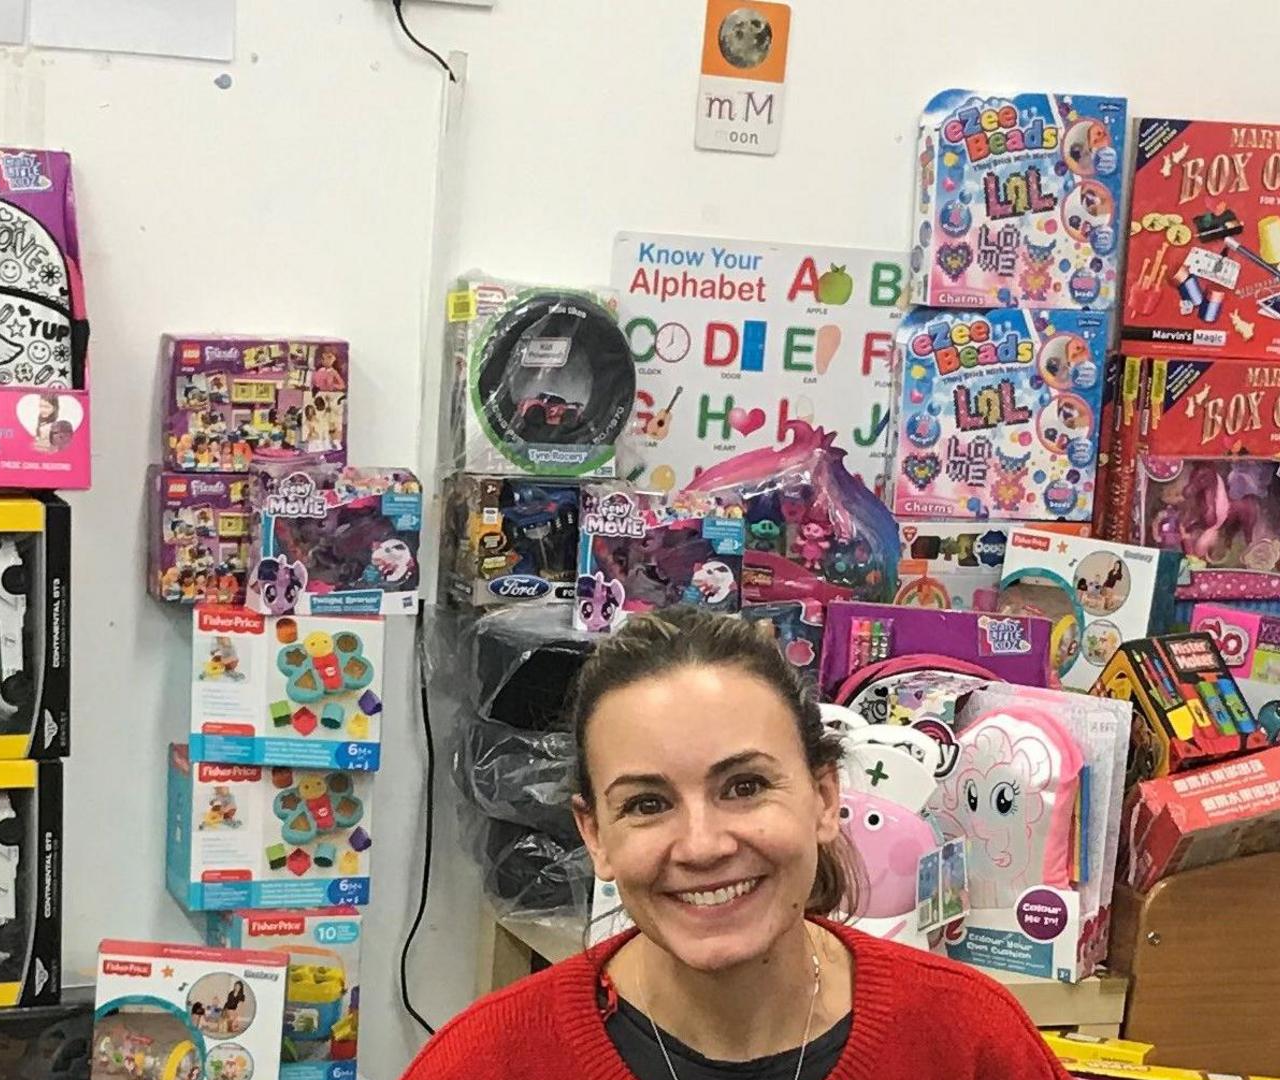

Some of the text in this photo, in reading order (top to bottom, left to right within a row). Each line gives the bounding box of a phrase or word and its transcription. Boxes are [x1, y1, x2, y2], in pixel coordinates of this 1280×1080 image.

[742, 91, 774, 125] M
[728, 131, 759, 145] oon
[966, 120, 1058, 162] Beads
[1179, 153, 1253, 204] BOX
[639, 243, 764, 271] Know Your
[629, 268, 767, 303] Alphabet
[787, 256, 821, 304] A
[870, 262, 904, 307] B
[939, 293, 985, 305] Charms
[29, 317, 70, 343] YUP
[704, 322, 739, 367] D
[783, 326, 816, 372] E
[935, 333, 1034, 375] Beads
[697, 394, 882, 447] H J
[1201, 391, 1266, 445] BOX
[904, 502, 953, 515] Charms
[499, 577, 540, 596] Ford
[318, 926, 337, 939] 10
